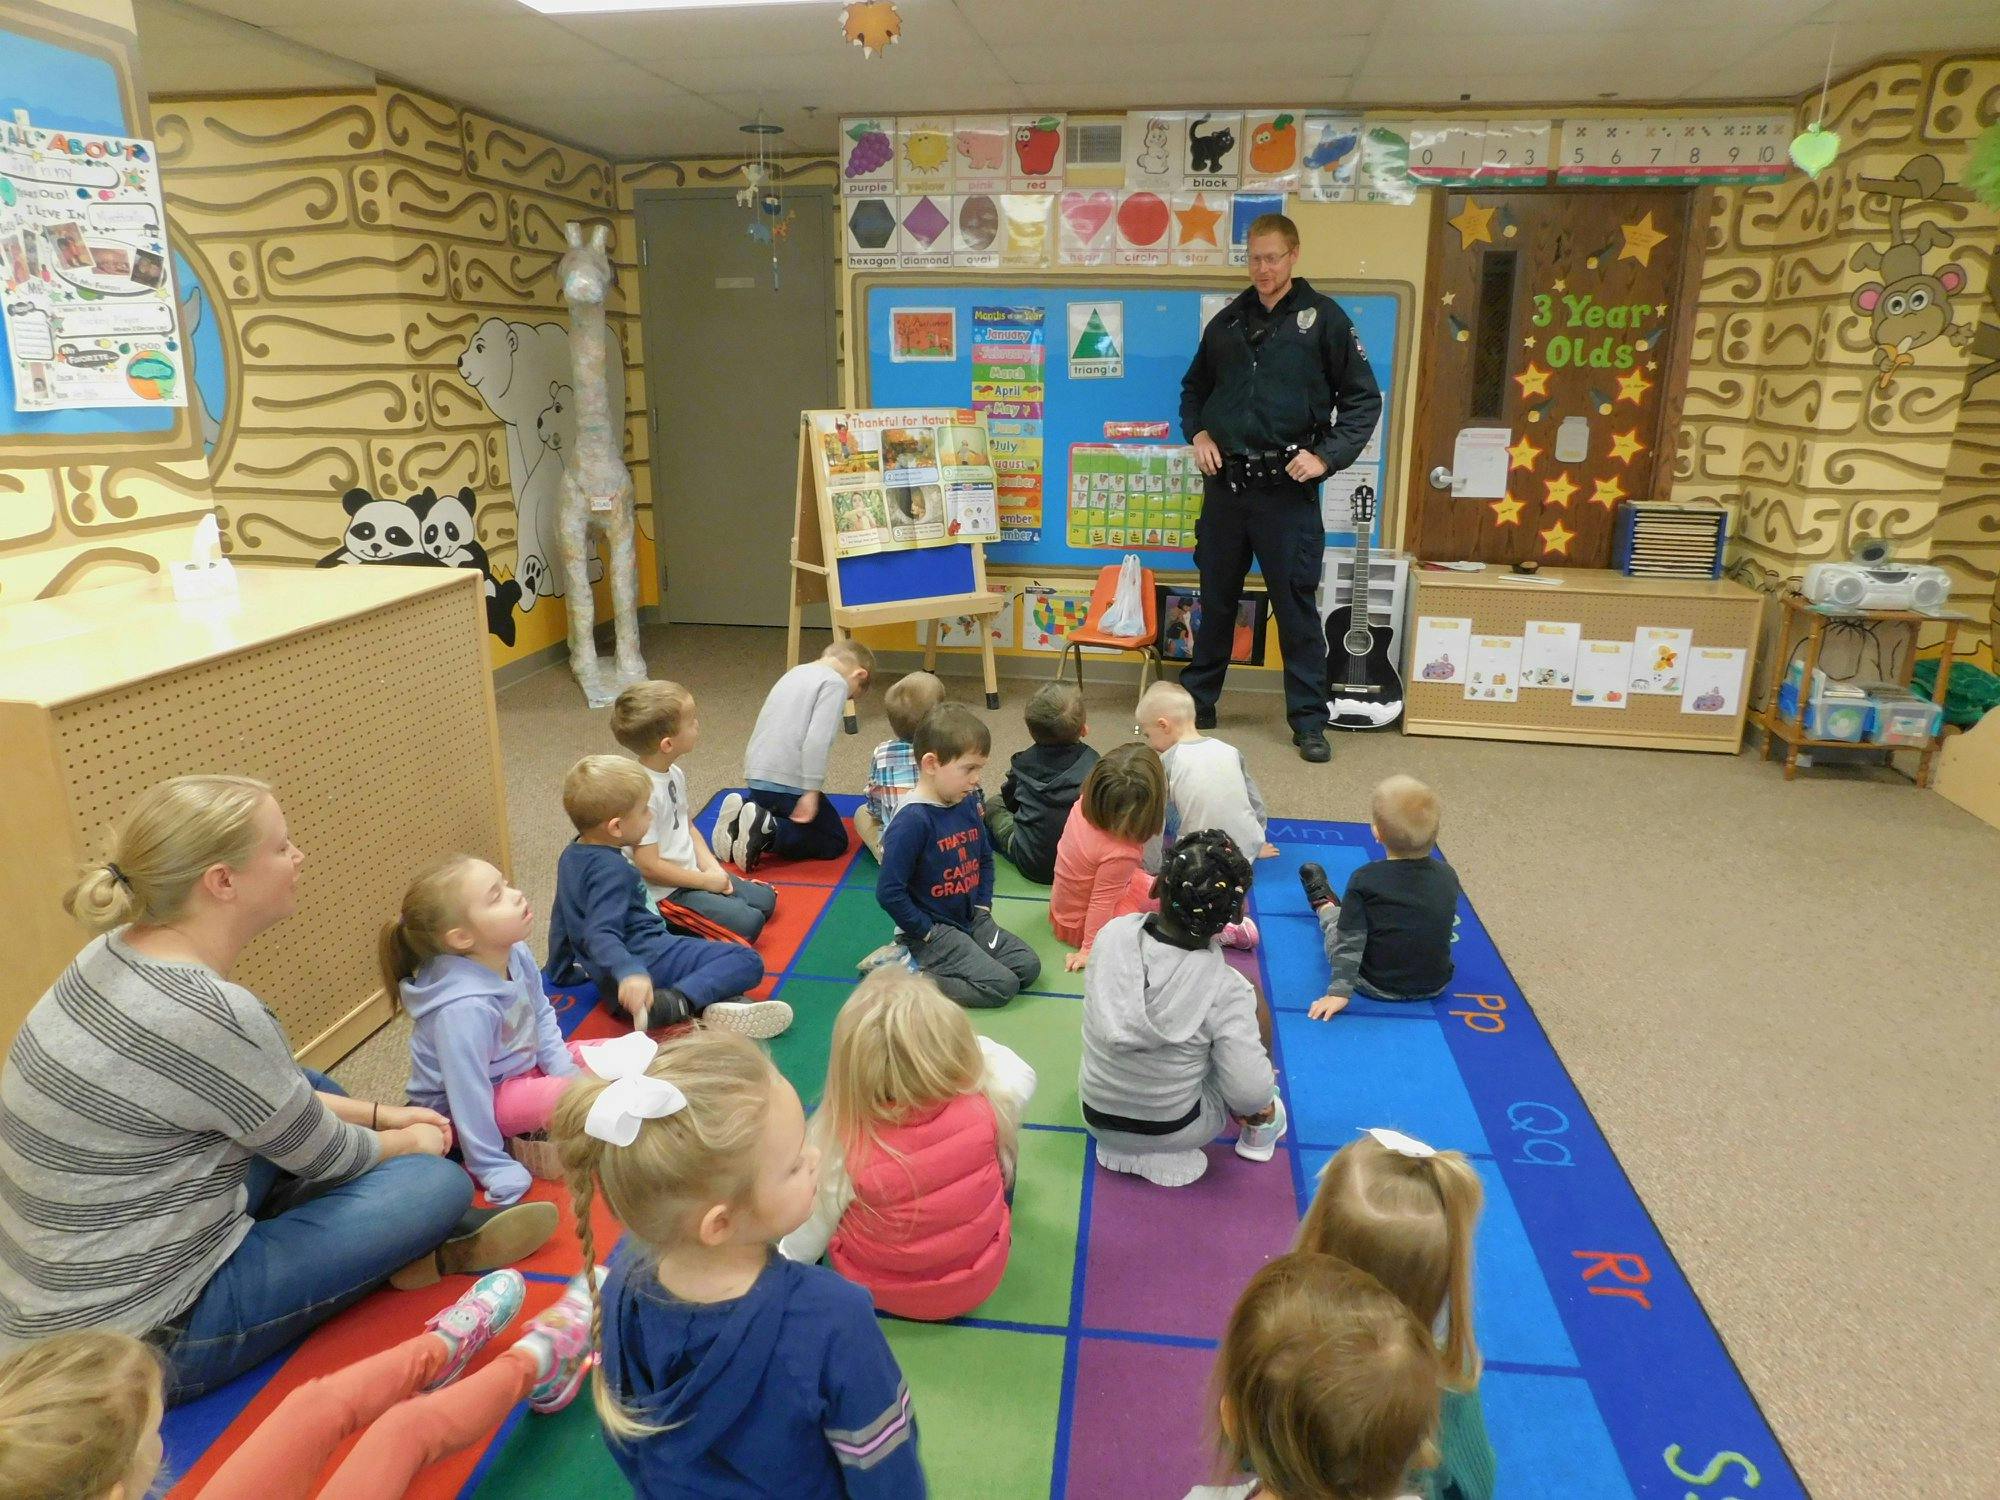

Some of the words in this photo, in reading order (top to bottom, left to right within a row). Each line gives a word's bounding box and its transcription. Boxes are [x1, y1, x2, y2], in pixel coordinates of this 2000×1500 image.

[47, 133, 137, 162] ABOUT
[1573, 147, 1585, 163] 5
[1728, 146, 1739, 163] 9
[1758, 145, 1775, 163] 10
[1421, 149, 1433, 165] 0
[1460, 150, 1466, 166] 1
[1524, 149, 1535, 165] 3
[1611, 149, 1622, 165] 6
[1650, 148, 1661, 165] 7
[1689, 147, 1700, 164] 8
[849, 182, 888, 193] purple
[906, 181, 946, 193] yellow
[968, 179, 994, 190] pink
[1026, 180, 1047, 190] red
[1193, 177, 1228, 188] black
[35, 205, 60, 219] LIVE
[66, 208, 86, 221] IN
[849, 256, 897, 267] hexagon
[903, 254, 949, 265] diamond
[966, 254, 991, 264] oval
[1124, 252, 1159, 262] circle
[1185, 253, 1209, 263] star
[974, 310, 1006, 320] Months
[1023, 310, 1043, 320] Year
[1532, 295, 1552, 327] 3
[1562, 295, 1651, 328] Year
[985, 328, 1031, 343] January
[980, 346, 1033, 362] February
[1546, 336, 1634, 369] Olds
[990, 366, 1025, 379] March
[1073, 365, 1118, 376] triangle
[994, 385, 1021, 397] April
[993, 402, 1020, 417] May
[851, 416, 899, 429] Thankful
[902, 414, 917, 426] for
[922, 413, 956, 426] Nature
[994, 440, 1018, 453] July
[994, 459, 1025, 471] ugust
[1000, 514, 1032, 524] ember
[1001, 528, 1033, 541] mber
[1448, 993, 1508, 1034] Pp
[1507, 1101, 1576, 1168] Qq
[1572, 1250, 1653, 1311] Rr
[1663, 1443, 1761, 1500] S
